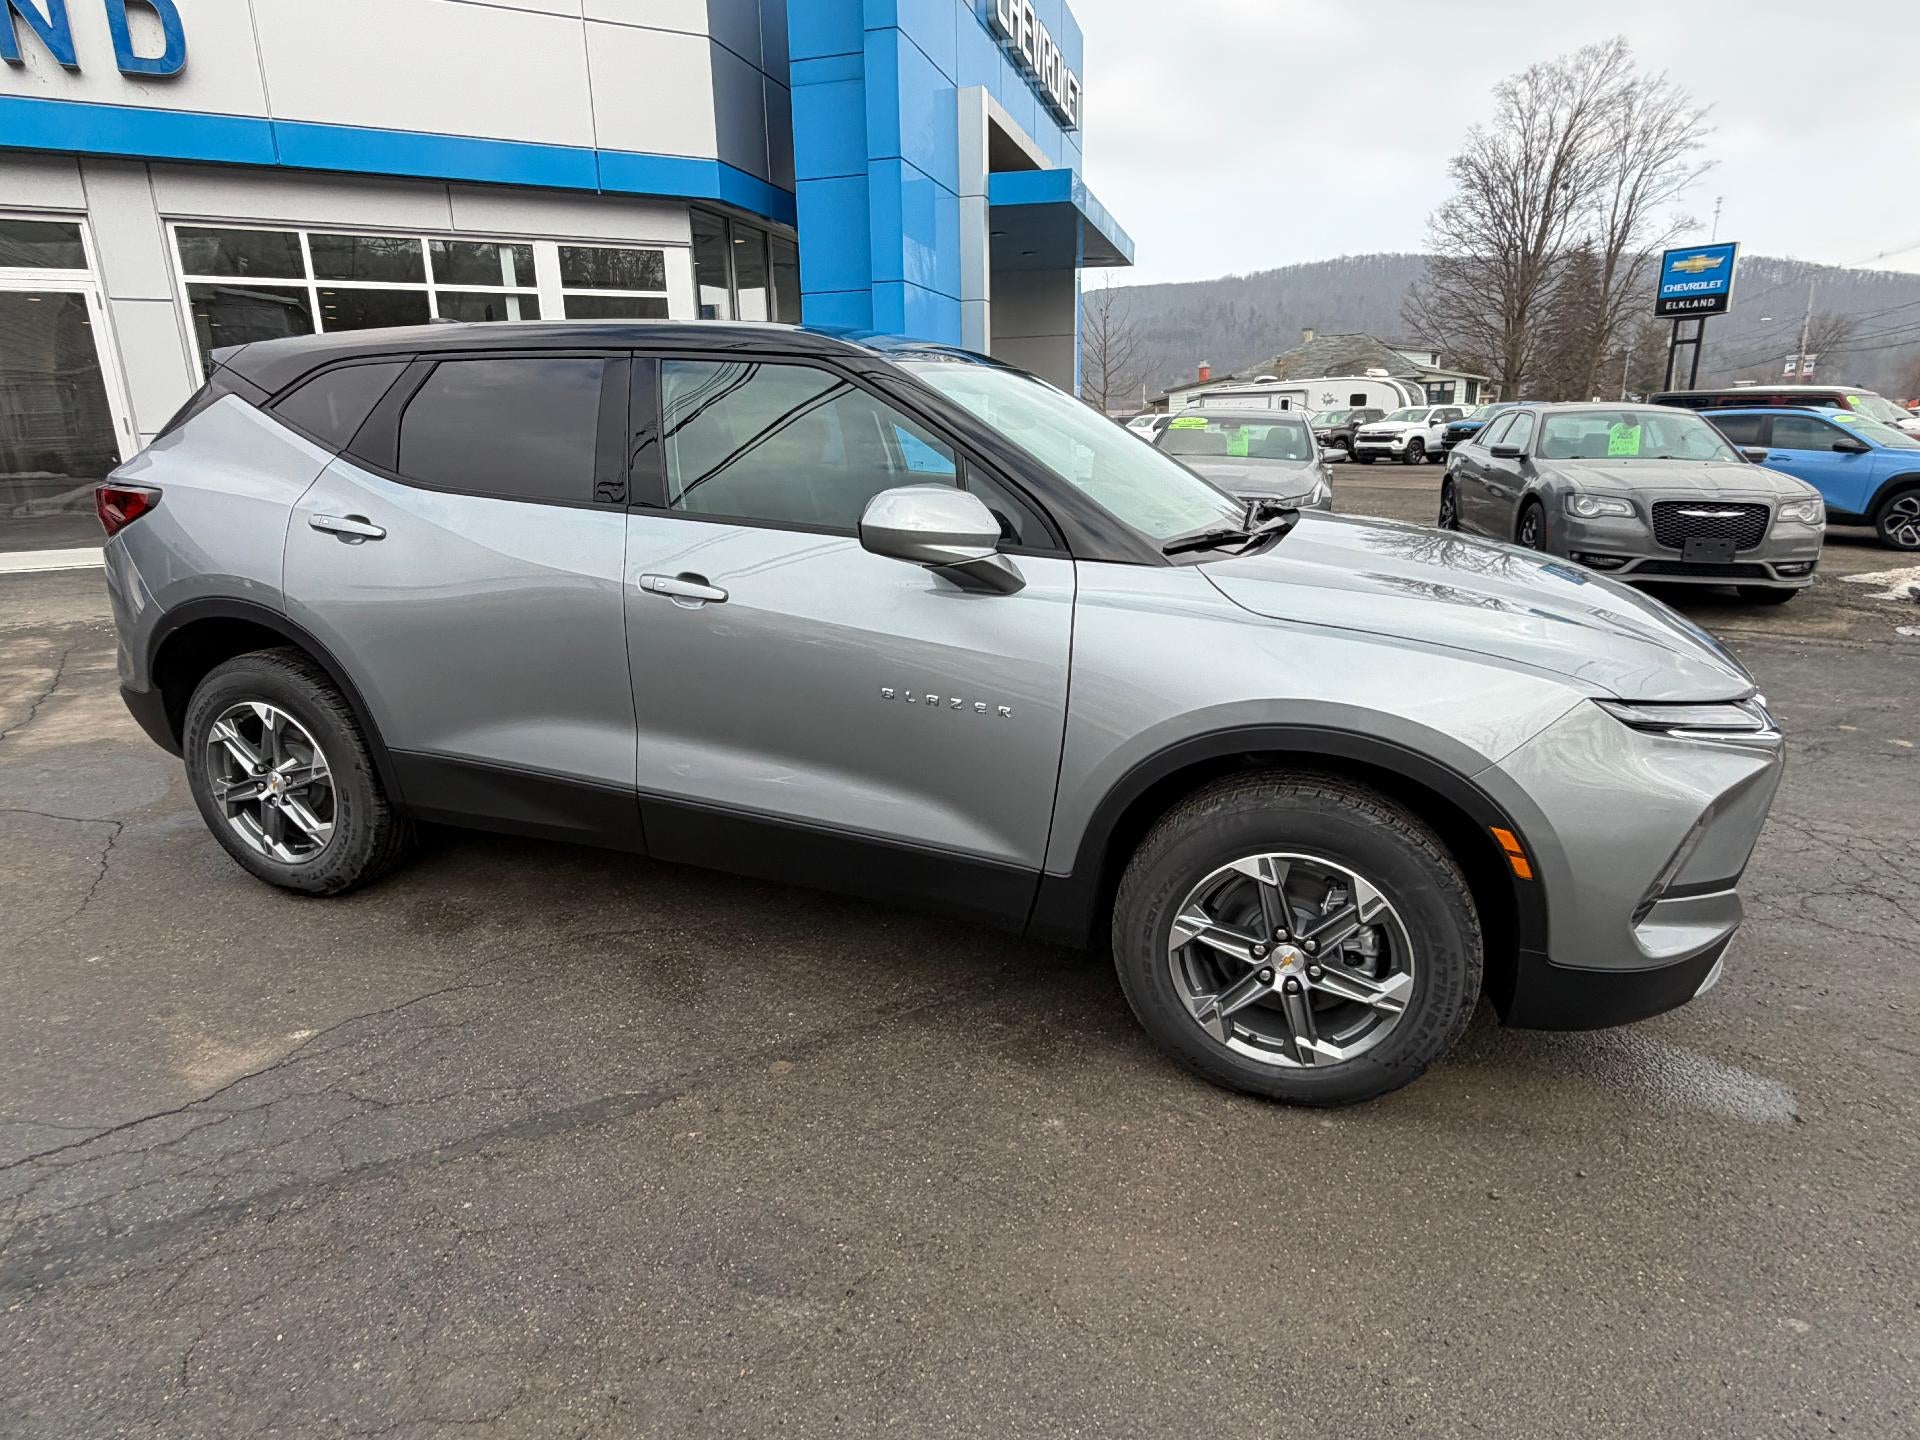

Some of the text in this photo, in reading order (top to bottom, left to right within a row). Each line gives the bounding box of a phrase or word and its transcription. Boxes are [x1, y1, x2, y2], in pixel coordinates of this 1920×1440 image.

[994, 0, 1081, 131] CHEVROLET
[1663, 280, 1724, 293] CHEVROLET
[1665, 298, 1716, 310] ELKLAND
[881, 687, 1012, 719] BLAZER
